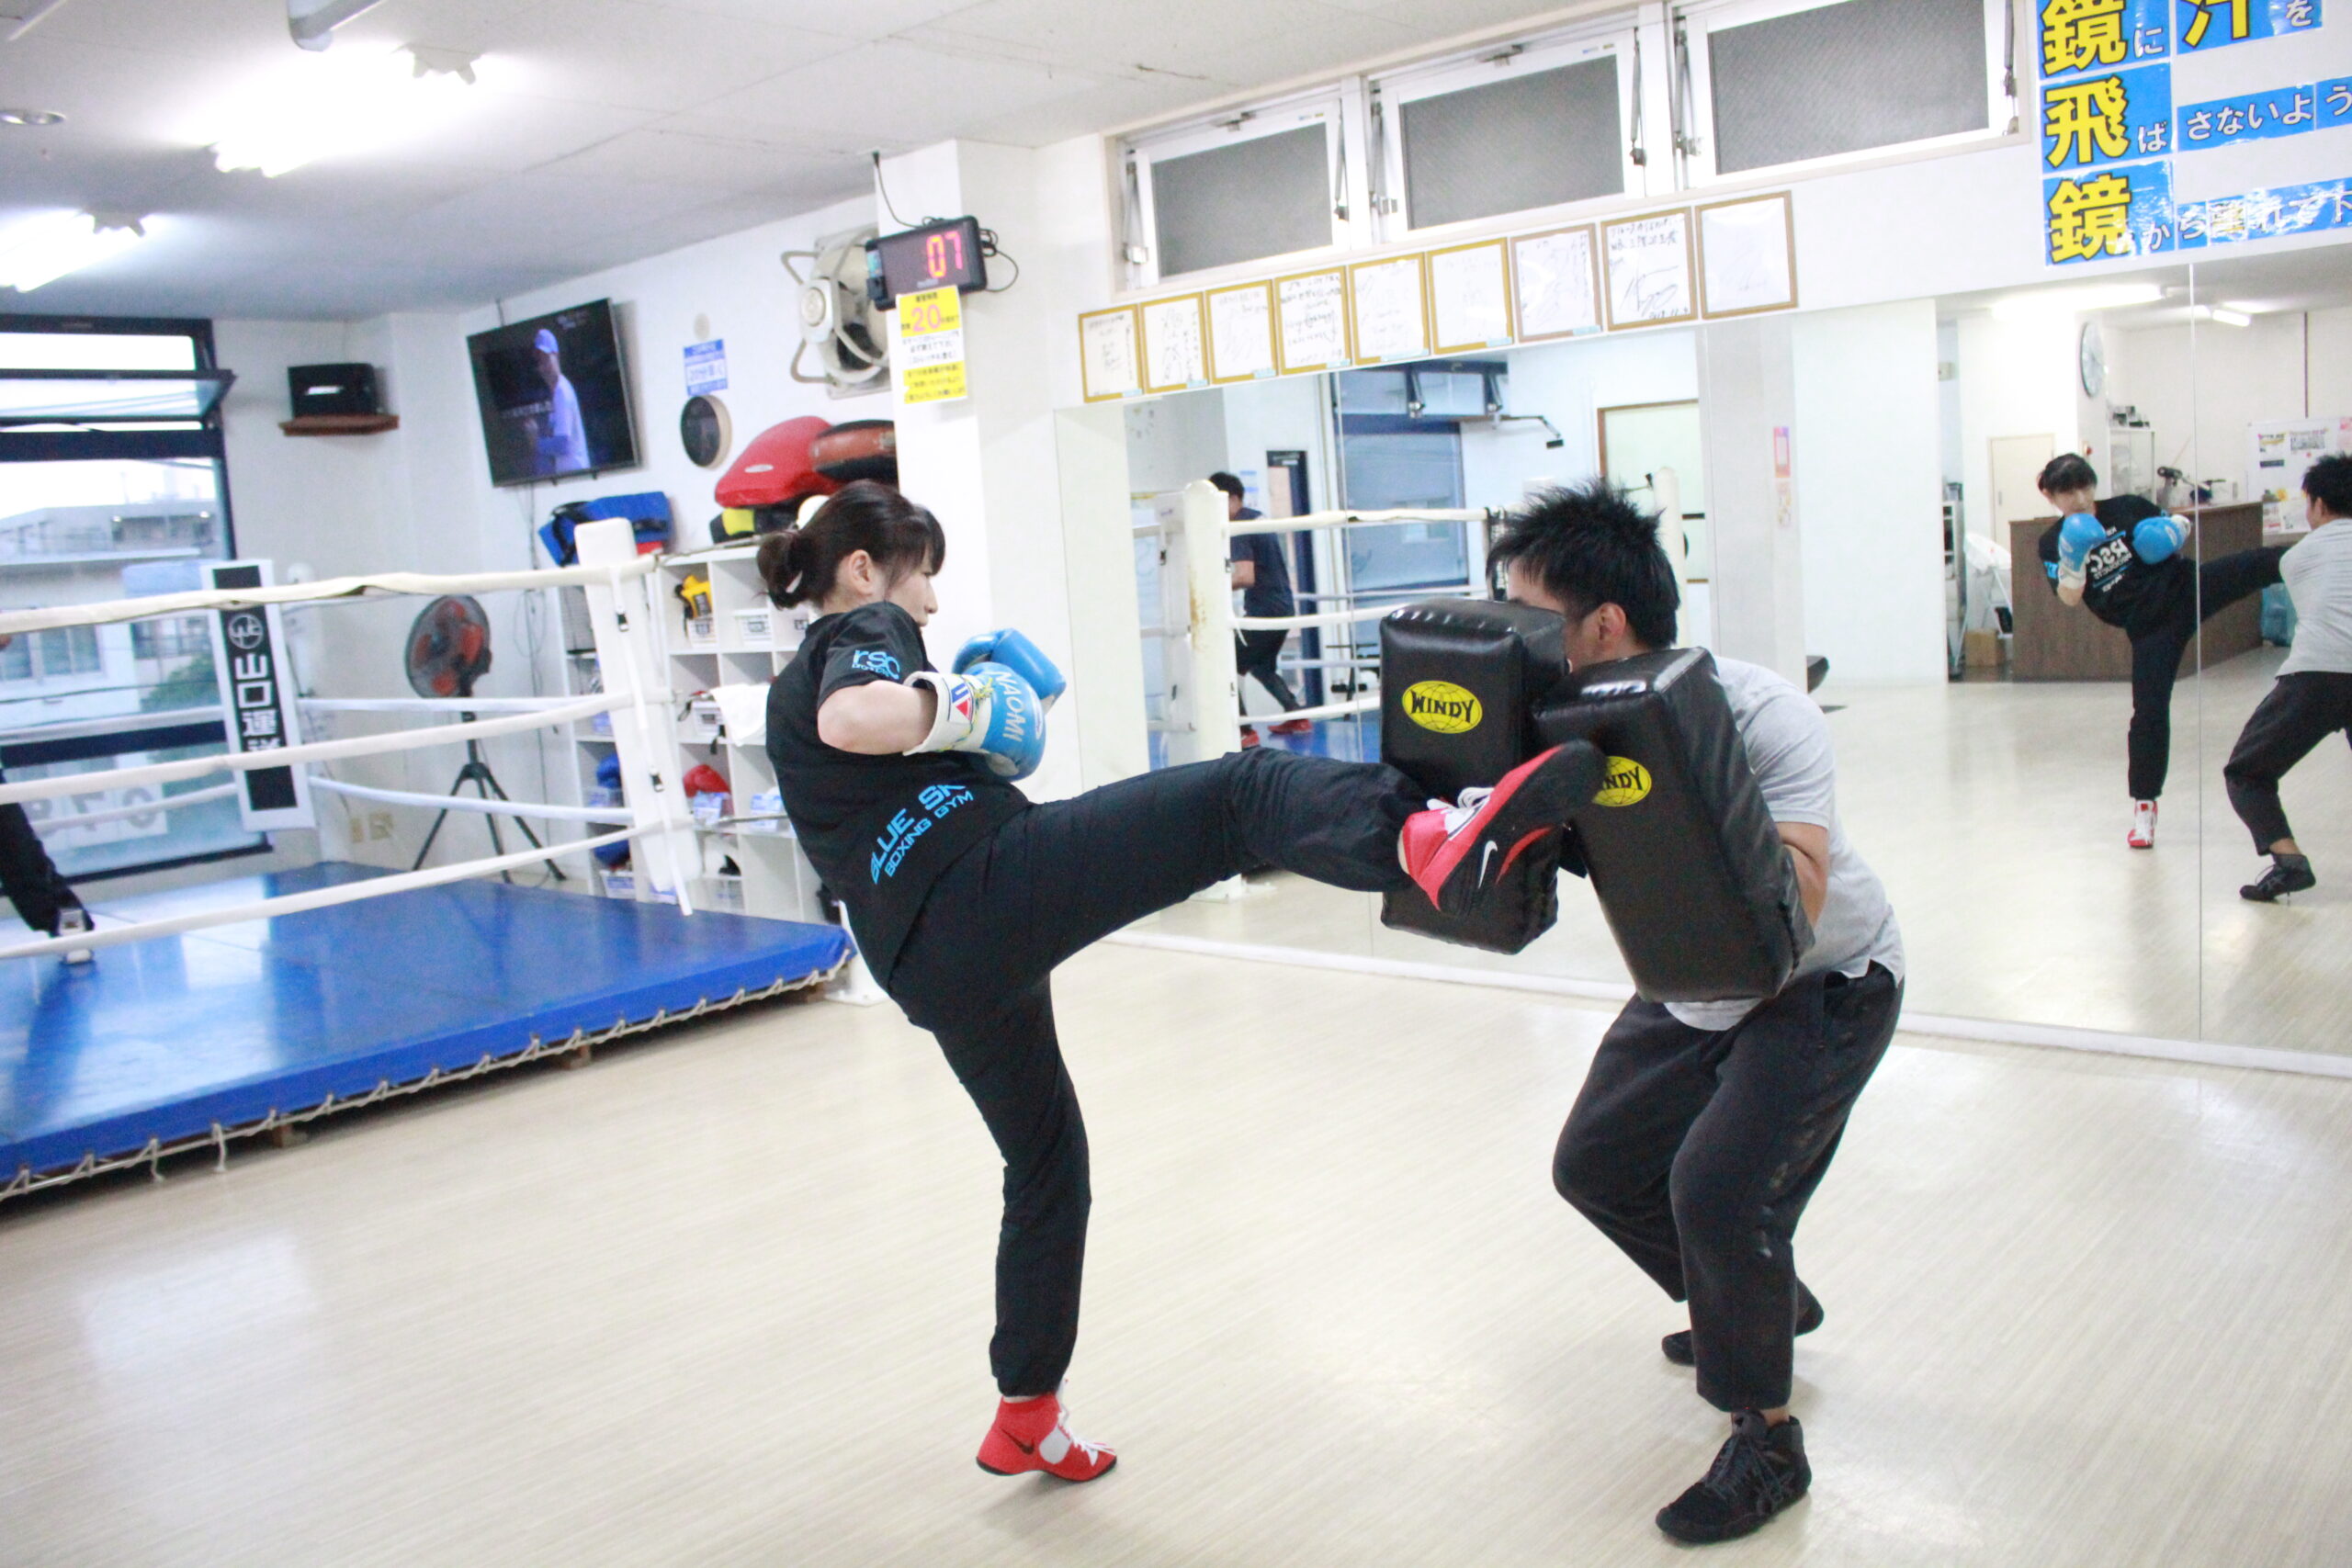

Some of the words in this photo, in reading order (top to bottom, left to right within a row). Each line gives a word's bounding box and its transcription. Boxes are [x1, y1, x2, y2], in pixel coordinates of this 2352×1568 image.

[926, 231, 963, 278] 07
[911, 304, 942, 333] 20
[992, 671, 1026, 743] NAOMI
[1410, 691, 1475, 723] WINDY
[1602, 766, 1644, 791] NDY
[918, 784, 967, 810] SK
[884, 818, 933, 878] BOXING
[933, 790, 974, 819] GYM
